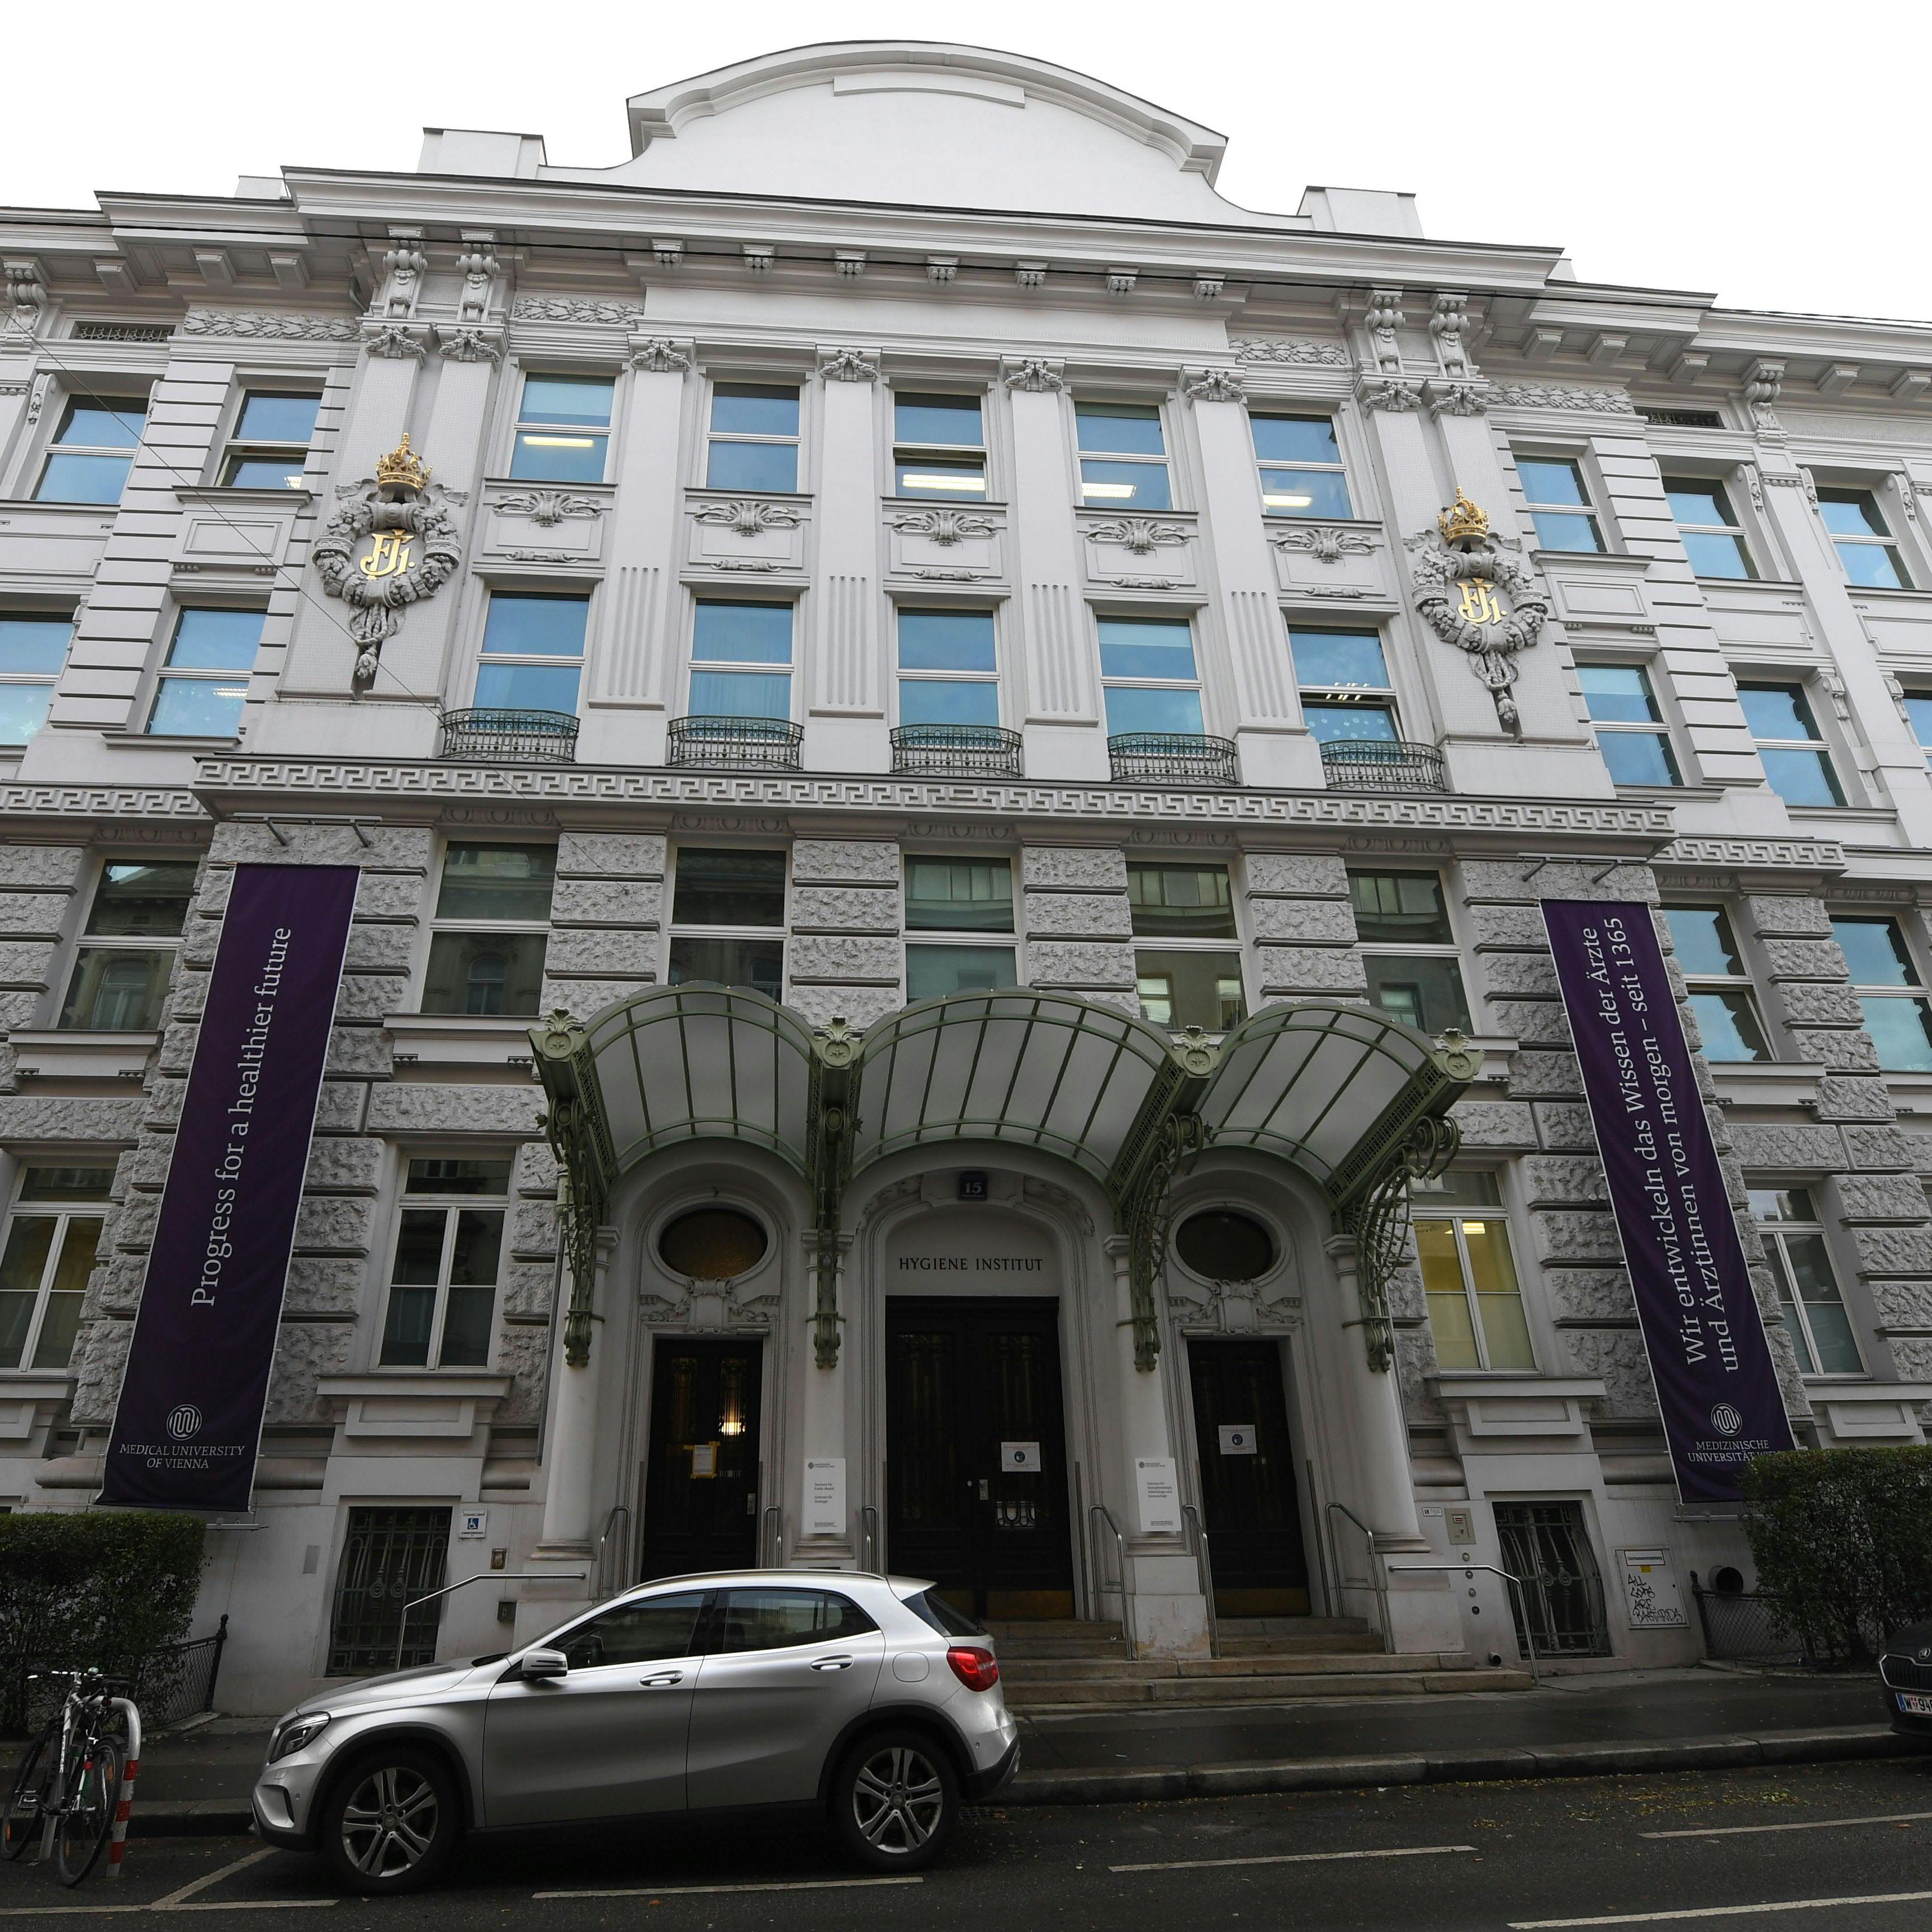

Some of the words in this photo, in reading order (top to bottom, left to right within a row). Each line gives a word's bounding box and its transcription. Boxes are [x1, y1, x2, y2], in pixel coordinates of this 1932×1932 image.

[254, 928, 291, 996] future
[1583, 928, 1611, 985] Ärzte
[1604, 918, 1635, 967] 1365
[1599, 989, 1621, 1025] der
[1621, 974, 1647, 1012] seit
[228, 1002, 273, 1114] healthier
[1611, 1031, 1645, 1113] Wissen
[1642, 1036, 1678, 1125] morgen
[231, 1121, 249, 1136] a
[1634, 1120, 1658, 1160] das
[215, 1143, 244, 1180] for
[1668, 1131, 1690, 1177] von
[964, 1182, 982, 1194] 15
[191, 1188, 235, 1306] Progress
[1644, 1167, 1694, 1306] entwickeln
[1681, 1183, 1725, 1313] Ärztinnen
[899, 1258, 968, 1271] HYGIENE
[976, 1258, 1043, 1271] INSTITUT
[1679, 1314, 1707, 1365] Wir
[1708, 1319, 1739, 1372] und
[119, 1443, 169, 1455] MEDICAL
[172, 1446, 245, 1456] UNIVERSITY
[146, 1457, 163, 1468] OF
[165, 1459, 209, 1469] VIENNA
[1688, 1450, 1754, 1462] UNIVERSITÄT
[1696, 1439, 1769, 1451] MEDIZINISCHE
[1628, 1574, 1647, 1587] ALL
[1634, 1599, 1656, 1611] ARE
[1903, 1697, 1912, 1710] W
